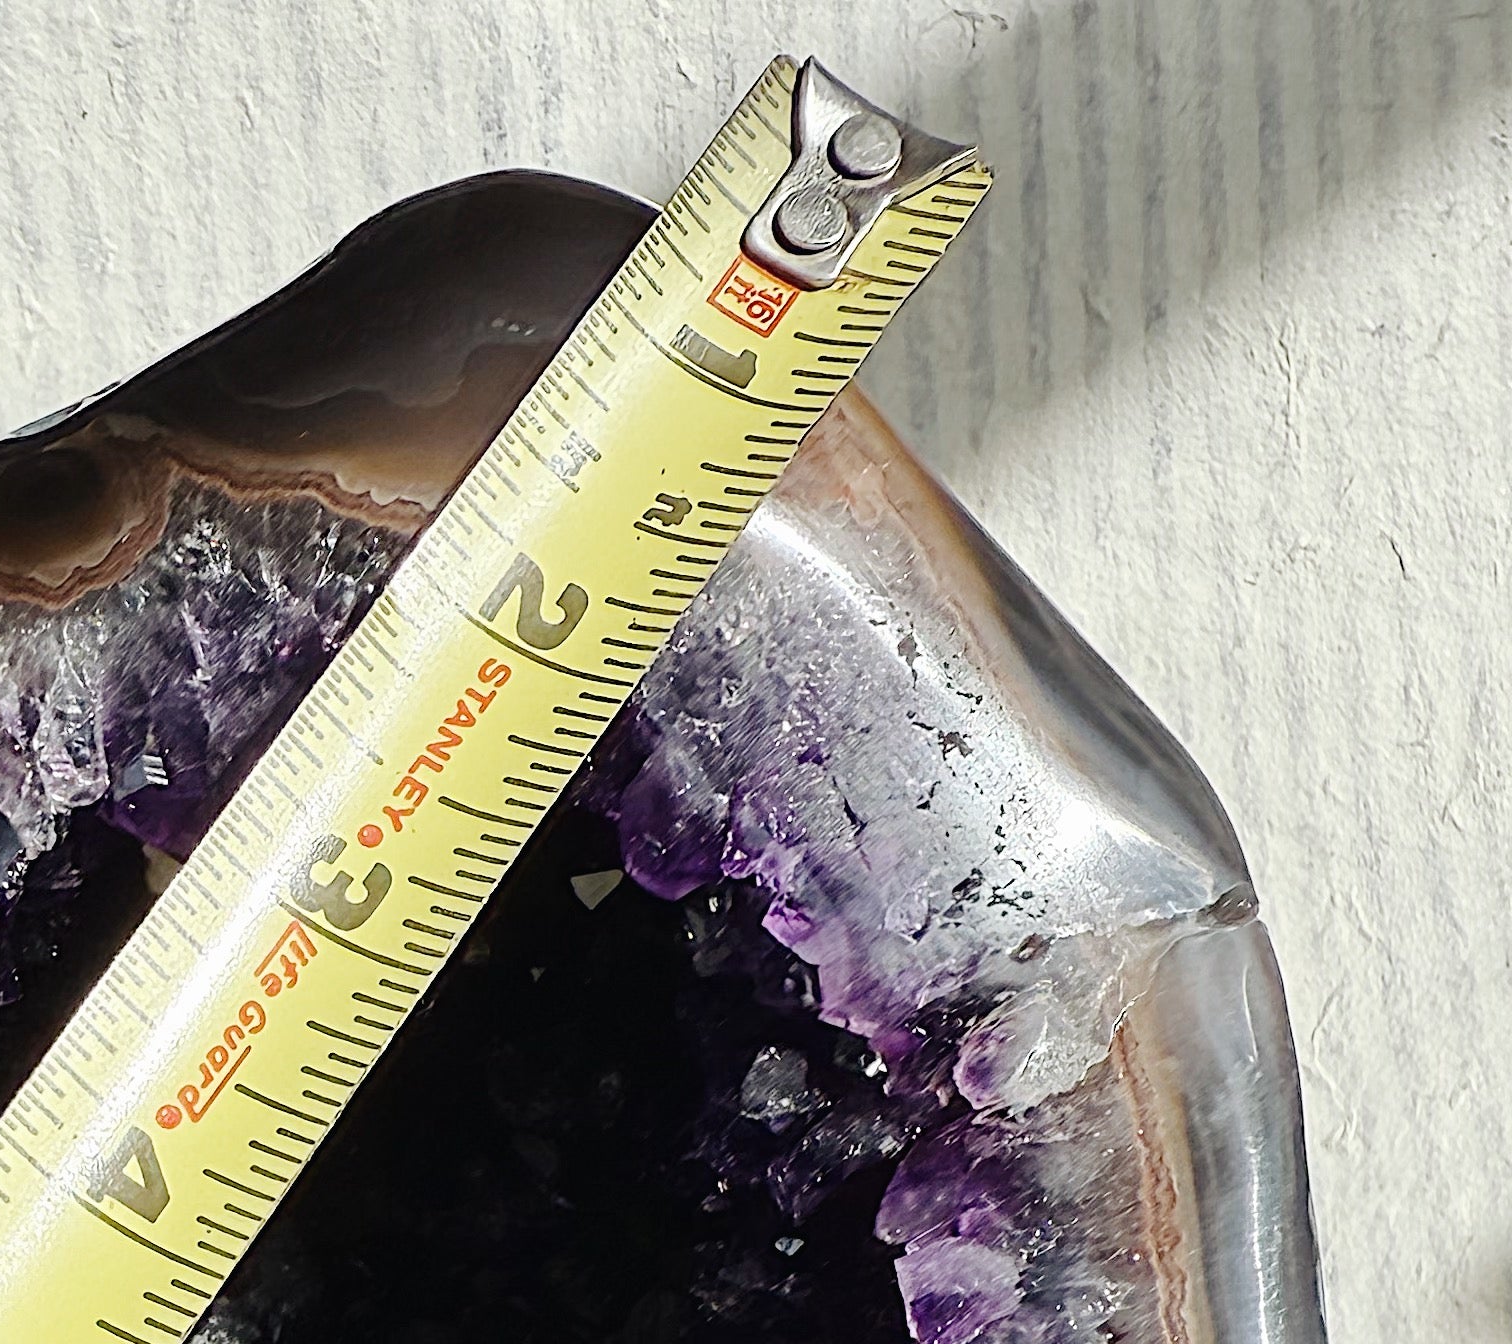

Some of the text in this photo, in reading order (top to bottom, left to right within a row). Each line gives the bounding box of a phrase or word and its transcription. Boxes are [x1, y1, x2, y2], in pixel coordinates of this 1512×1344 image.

[746, 288, 783, 323] 16
[668, 324, 757, 389] 1
[479, 552, 589, 650] 2
[382, 657, 512, 832] STANLEY
[290, 834, 393, 931] 3
[177, 919, 318, 1123] Life Guard
[86, 1126, 170, 1224] 4
